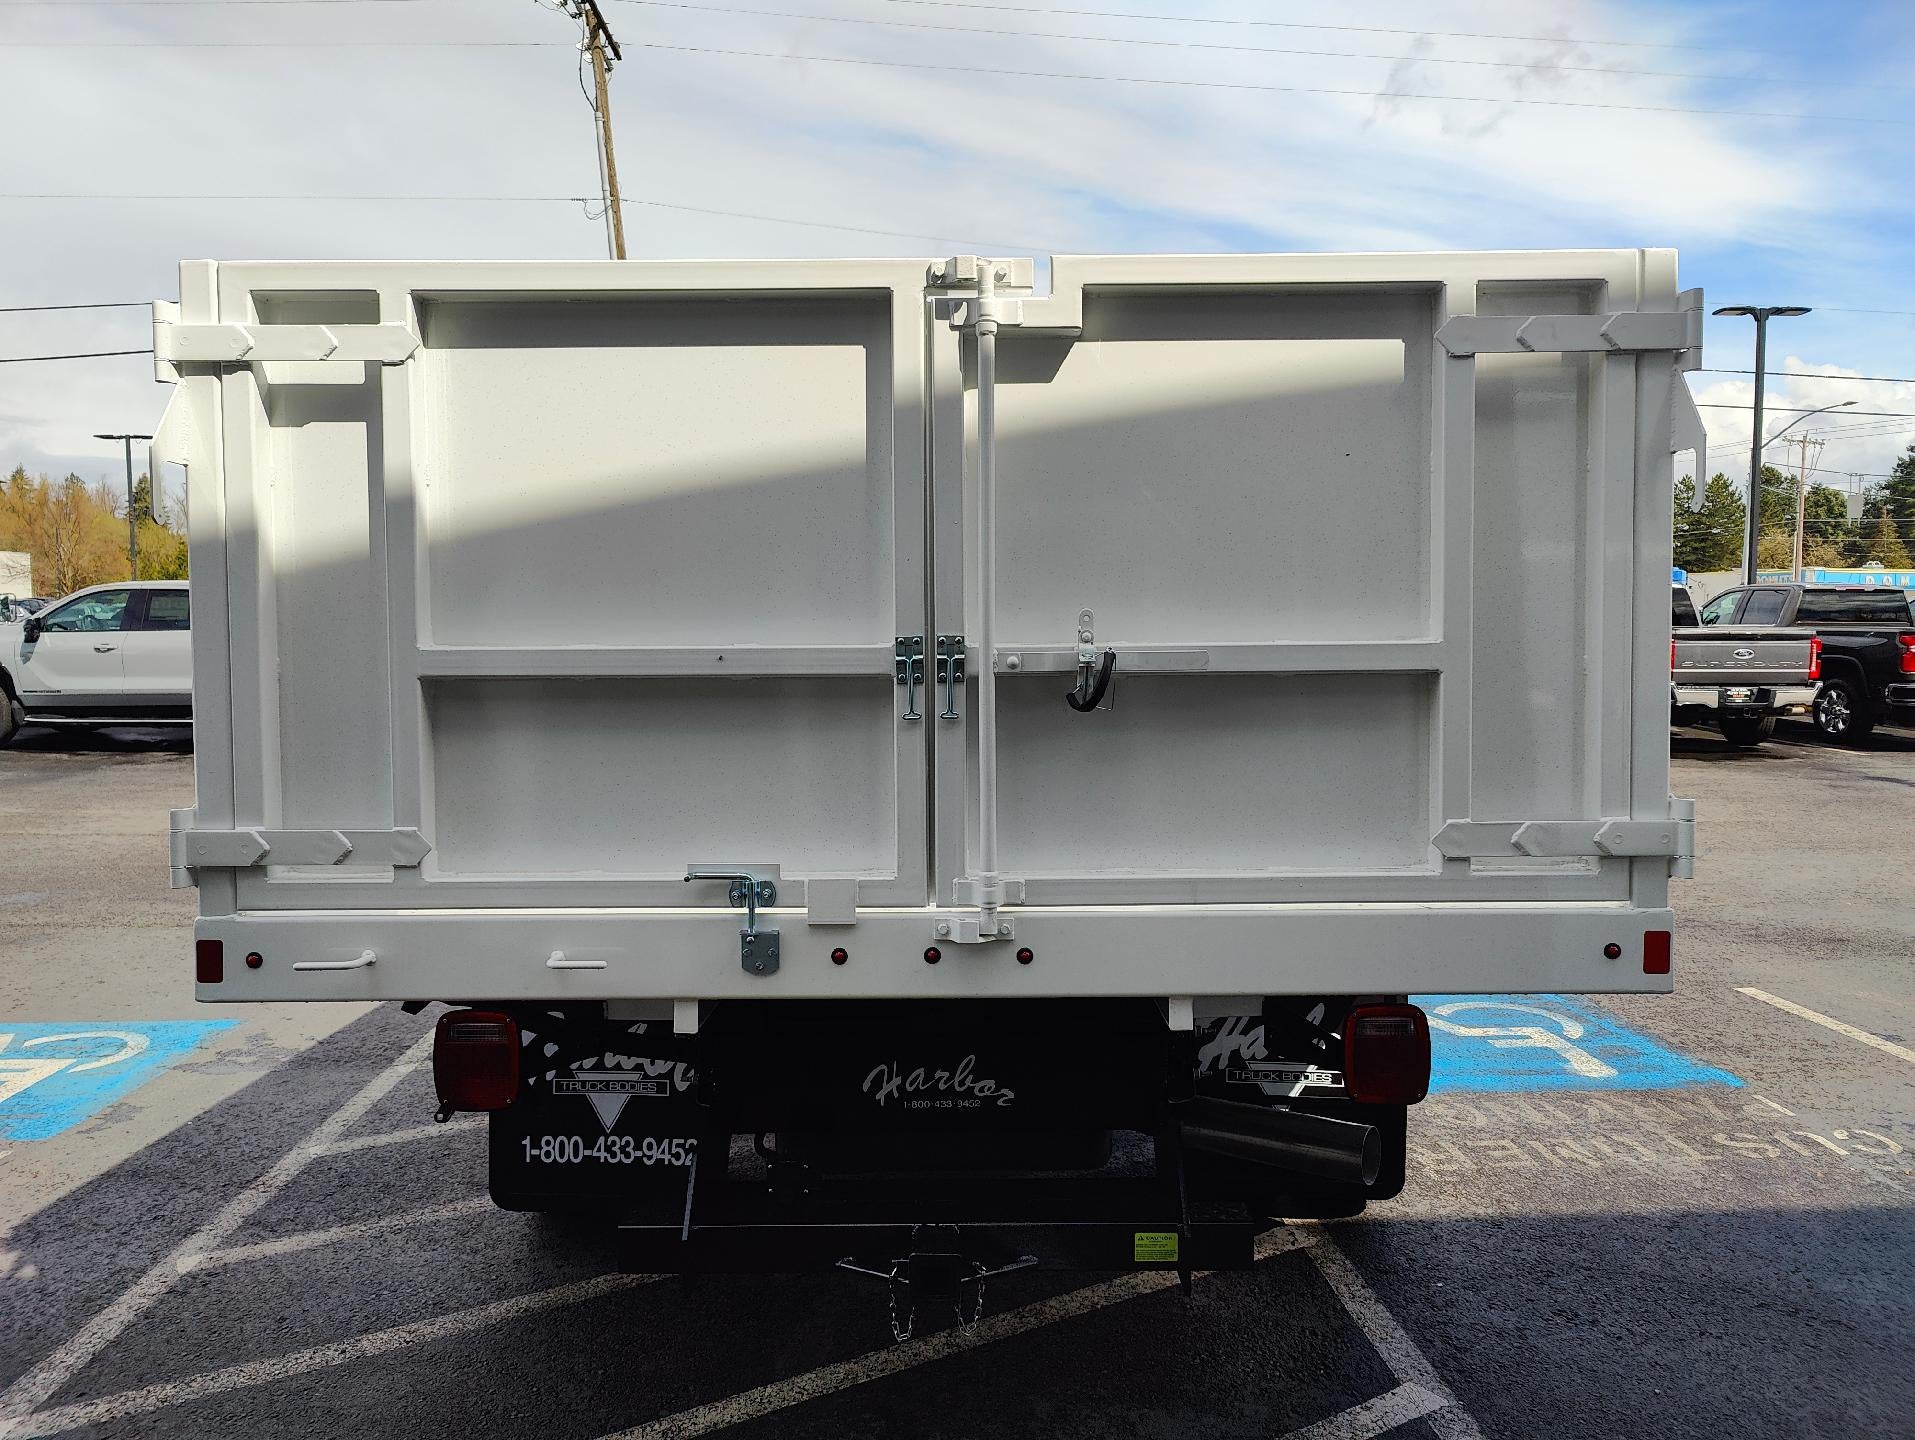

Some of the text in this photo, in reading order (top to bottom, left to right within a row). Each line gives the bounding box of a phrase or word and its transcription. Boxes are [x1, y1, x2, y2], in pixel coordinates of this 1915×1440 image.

[862, 1054, 1015, 1107] Harbor
[1233, 1070, 1332, 1083] TRUCK BODIES
[560, 1081, 657, 1093] TRUCK BODIES
